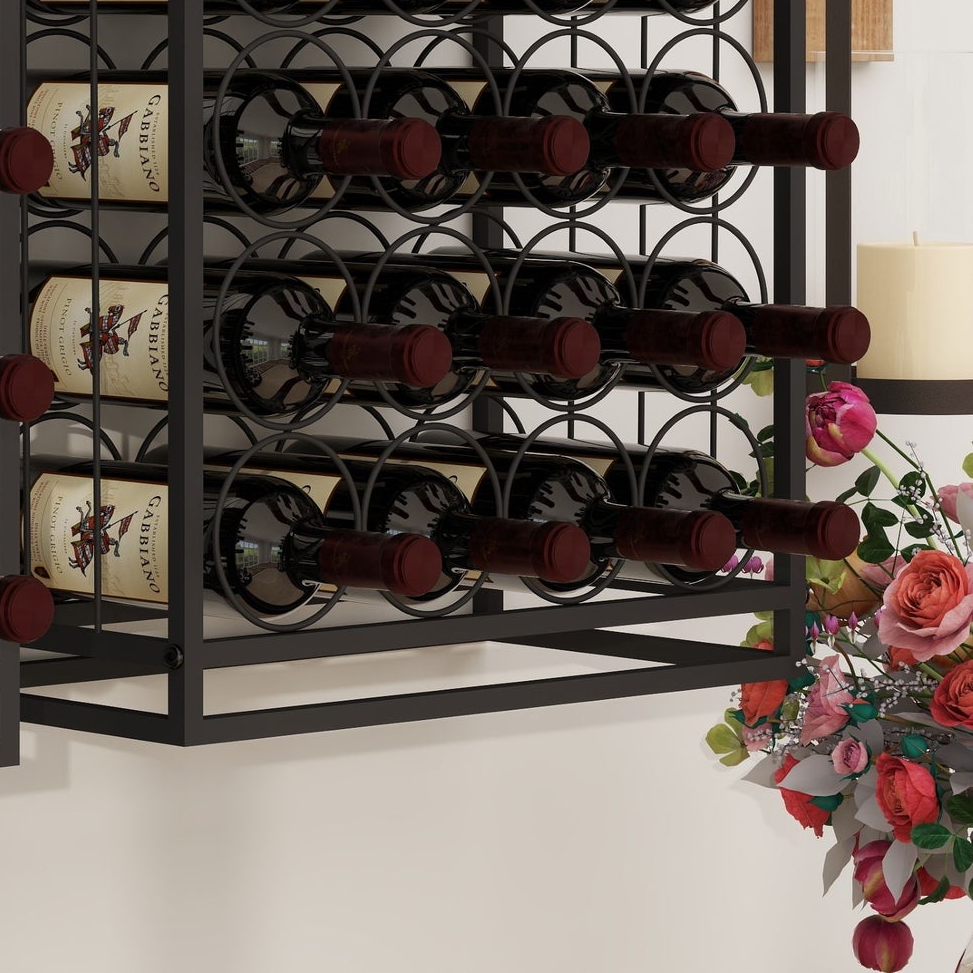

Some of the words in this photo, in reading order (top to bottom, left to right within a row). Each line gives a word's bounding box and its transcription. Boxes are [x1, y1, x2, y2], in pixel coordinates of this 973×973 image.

[50, 102, 63, 137] PINOT
[139, 94, 162, 193] GABBIANO
[58, 298, 73, 333] PINOT
[59, 336, 73, 376] GRIGIO
[148, 294, 169, 392] GABBIANO
[50, 496, 64, 530] PINOT
[50, 534, 63, 575] GRIGIO
[139, 495, 162, 594] GABBIANO
